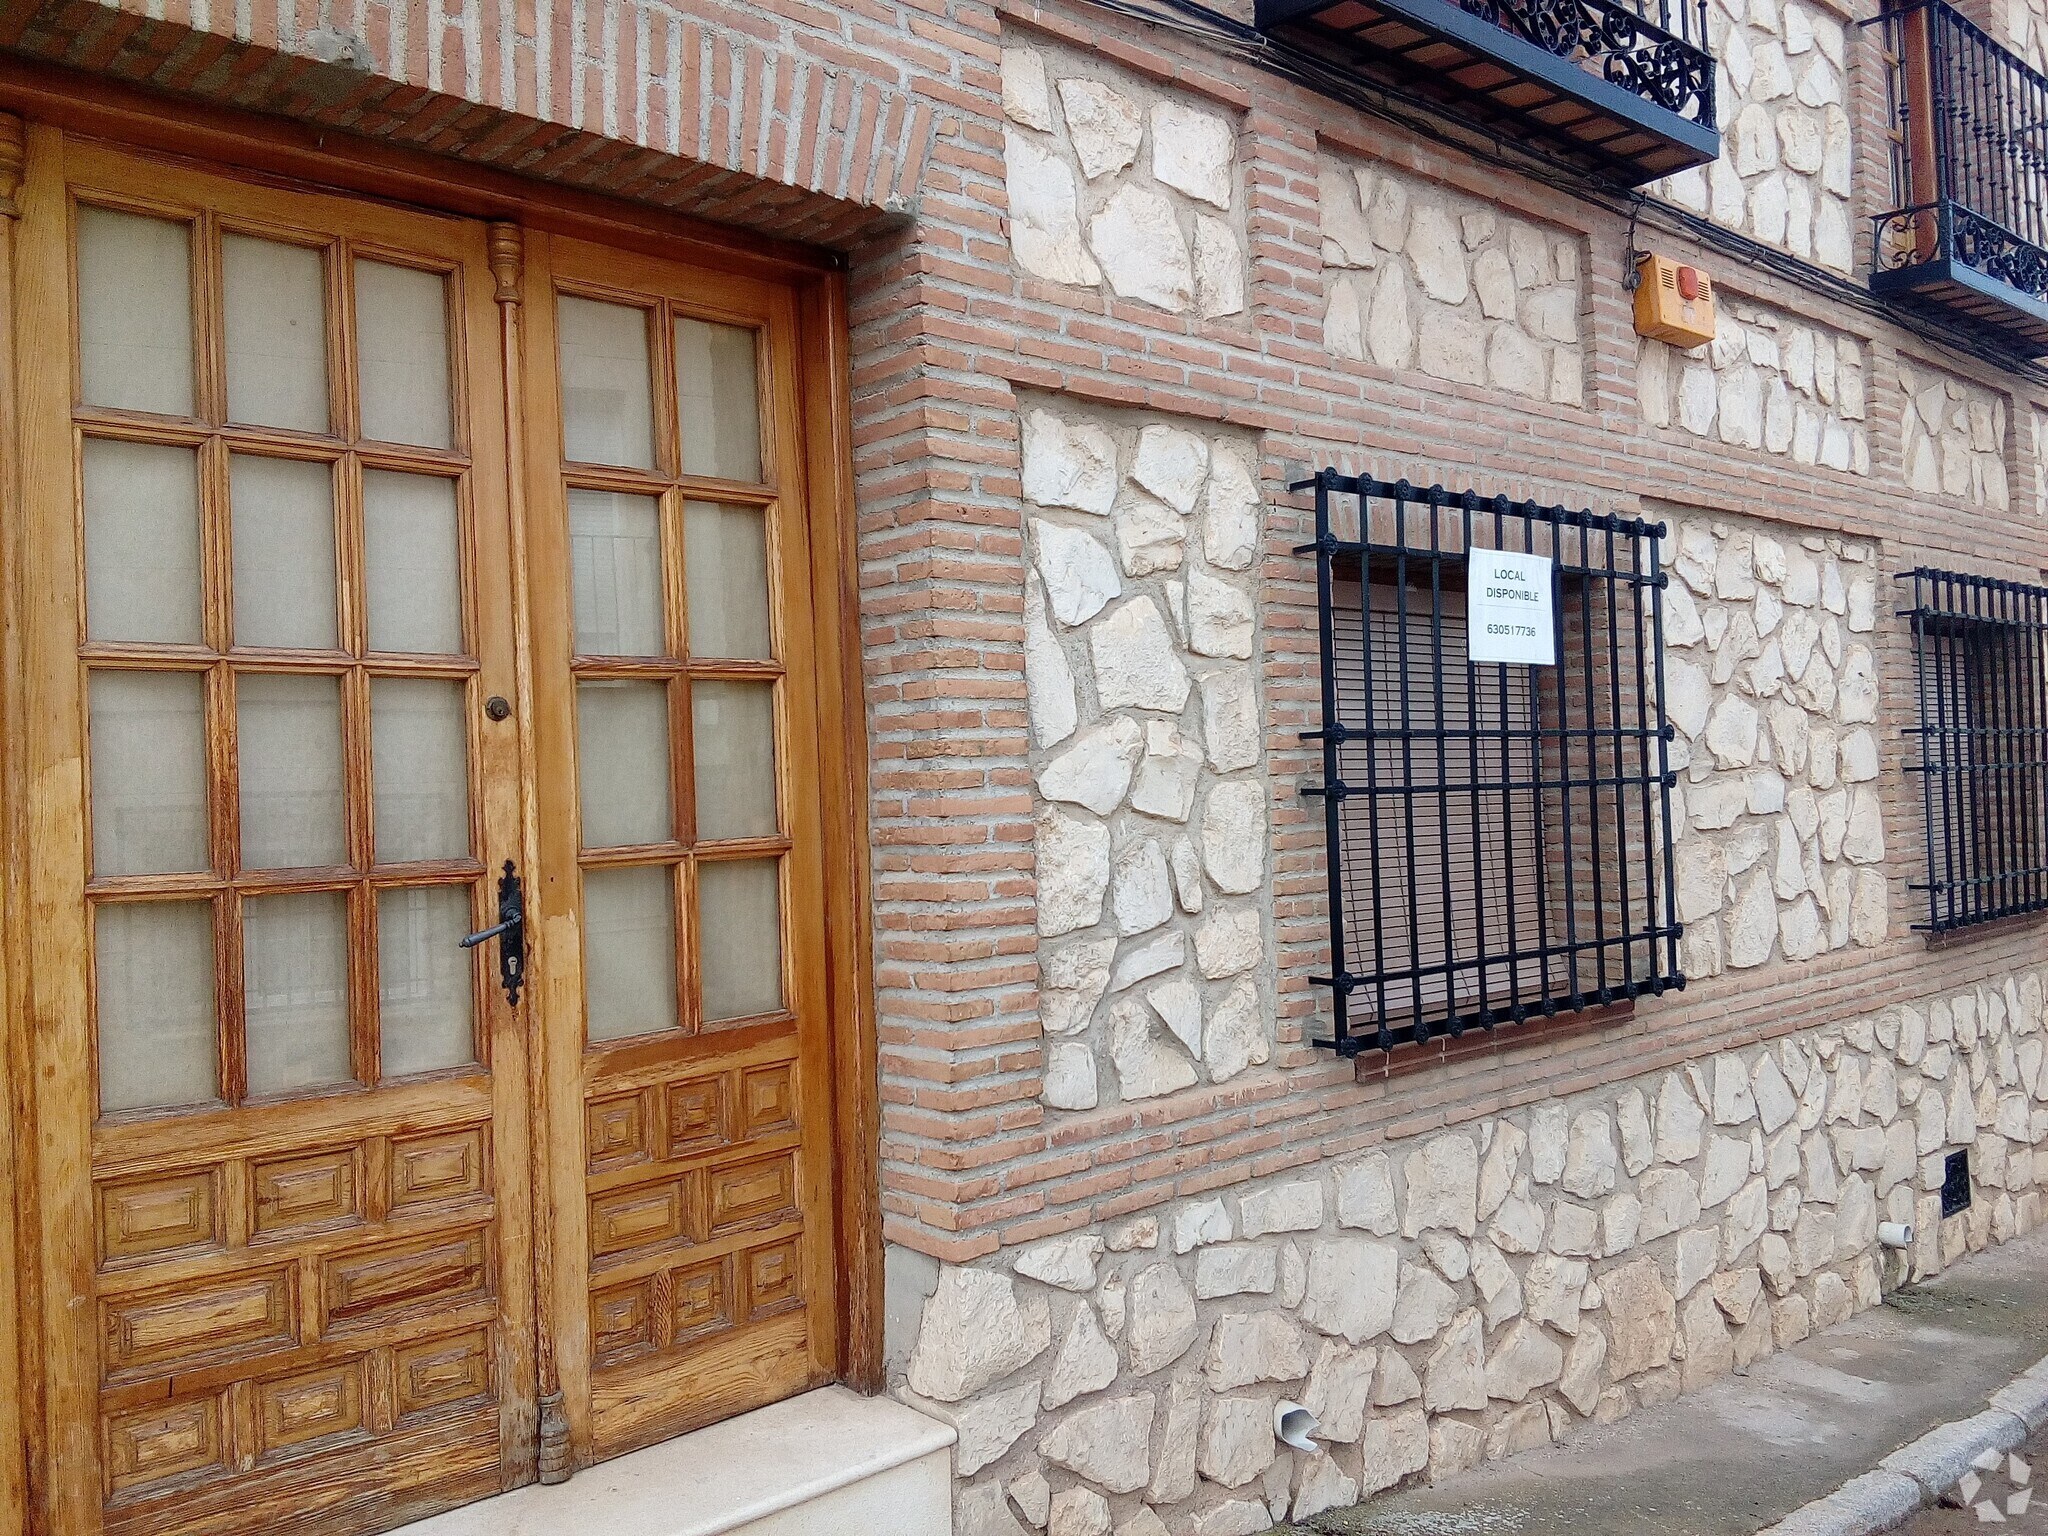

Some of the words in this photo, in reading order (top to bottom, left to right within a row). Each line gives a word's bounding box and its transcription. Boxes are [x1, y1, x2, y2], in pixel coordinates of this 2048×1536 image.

[1494, 568, 1526, 581] LOCAL
[1486, 587, 1539, 602] DISPONIBLE
[1487, 623, 1536, 637] 630517736
